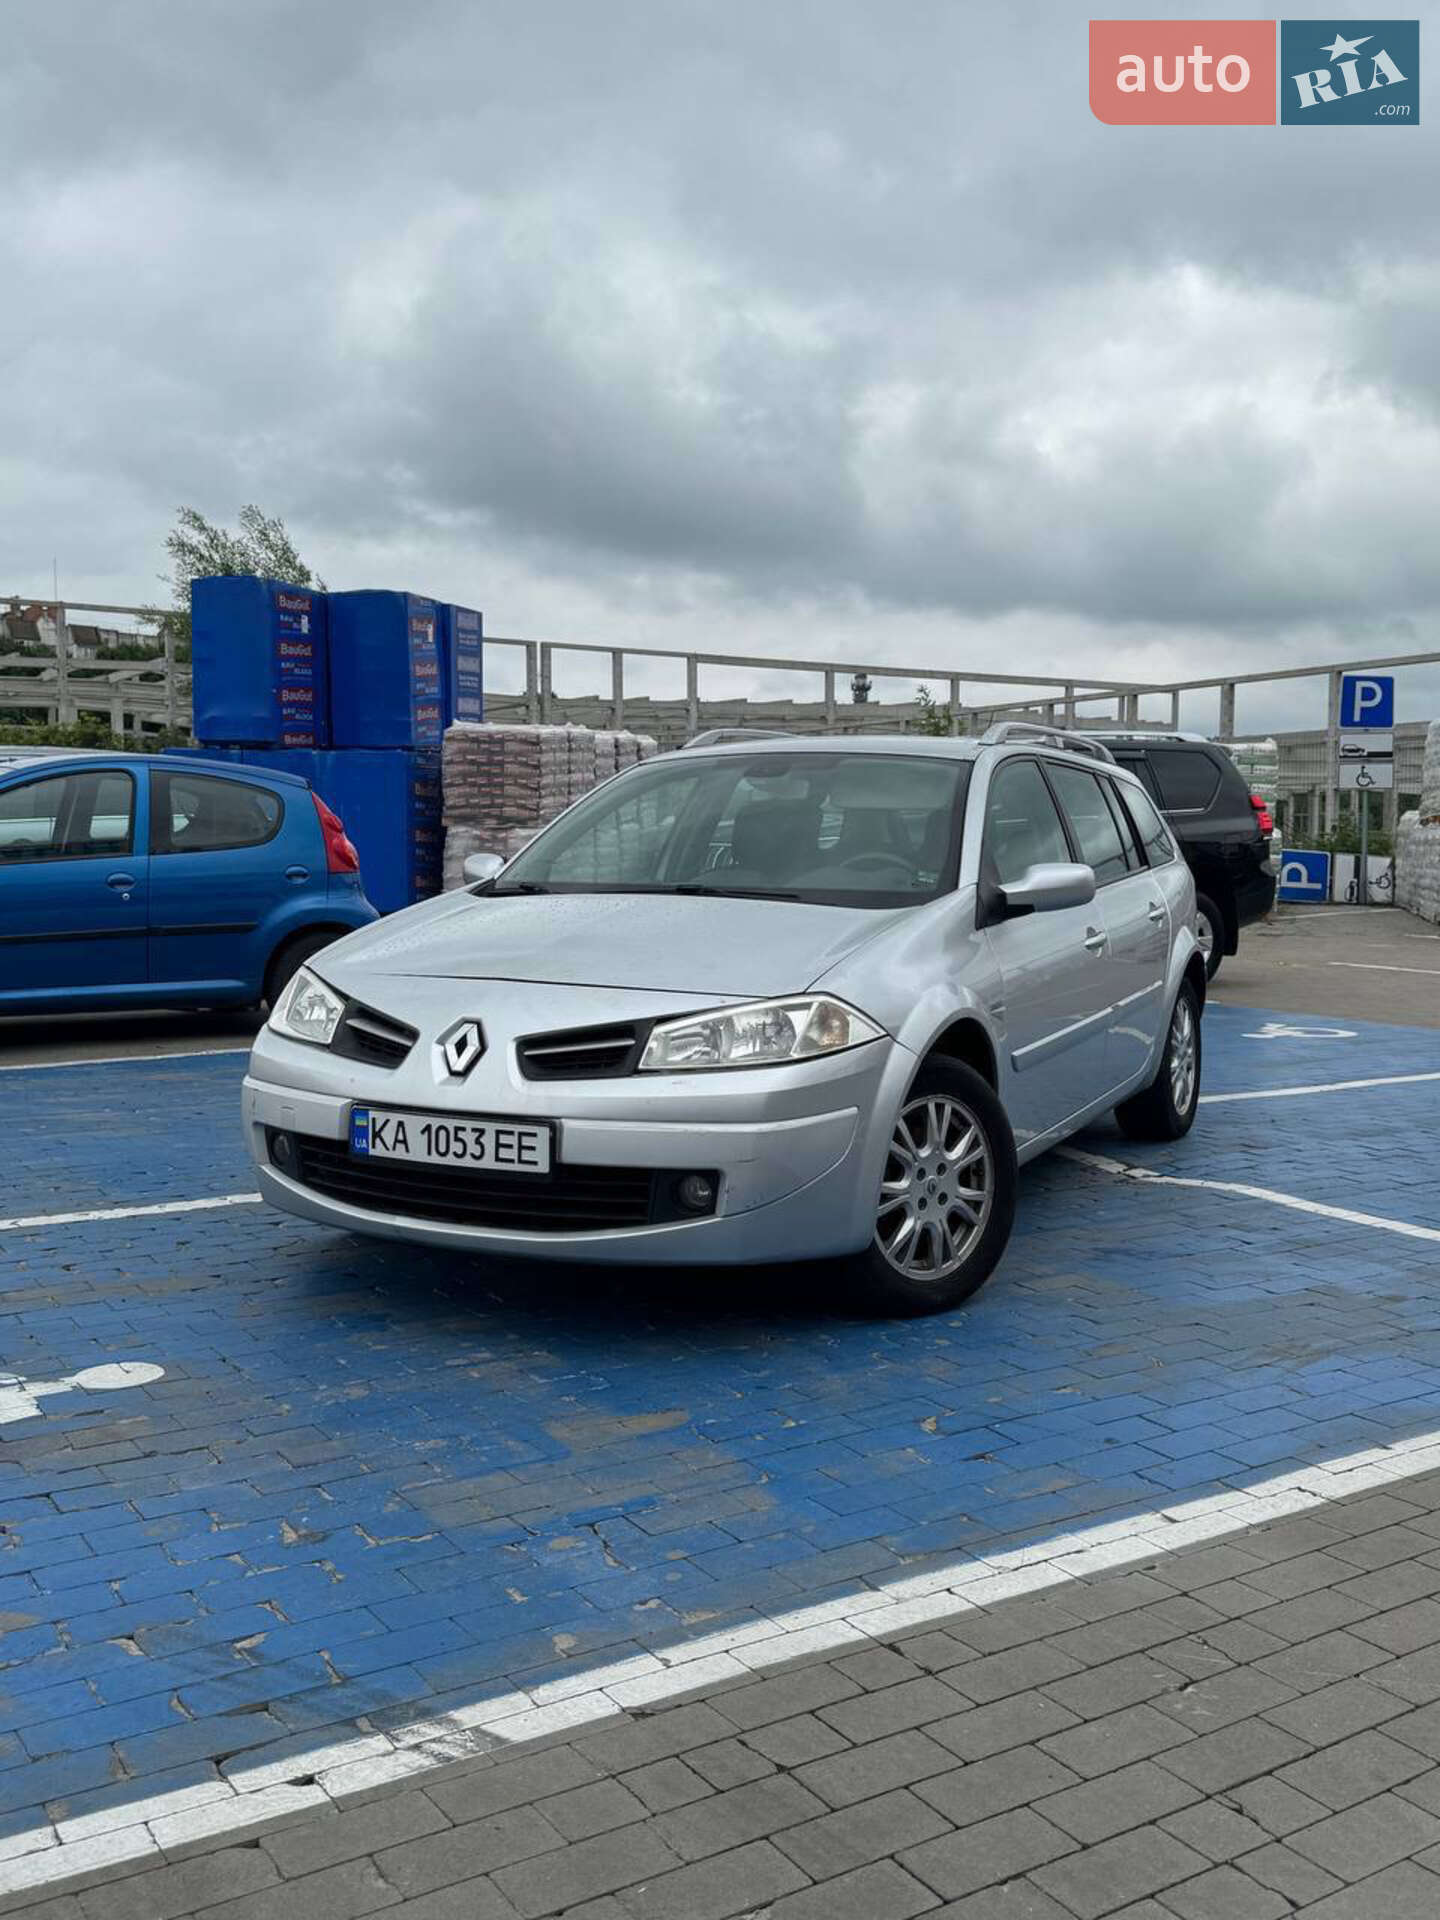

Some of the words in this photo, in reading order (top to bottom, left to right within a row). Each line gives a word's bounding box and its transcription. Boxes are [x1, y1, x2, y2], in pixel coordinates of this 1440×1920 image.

[1353, 680, 1383, 722] P
[1280, 862, 1322, 889] P
[354, 1138, 368, 1149] UA
[371, 1117, 410, 1153] KA
[420, 1123, 486, 1161] 1053
[494, 1129, 539, 1166] EE
